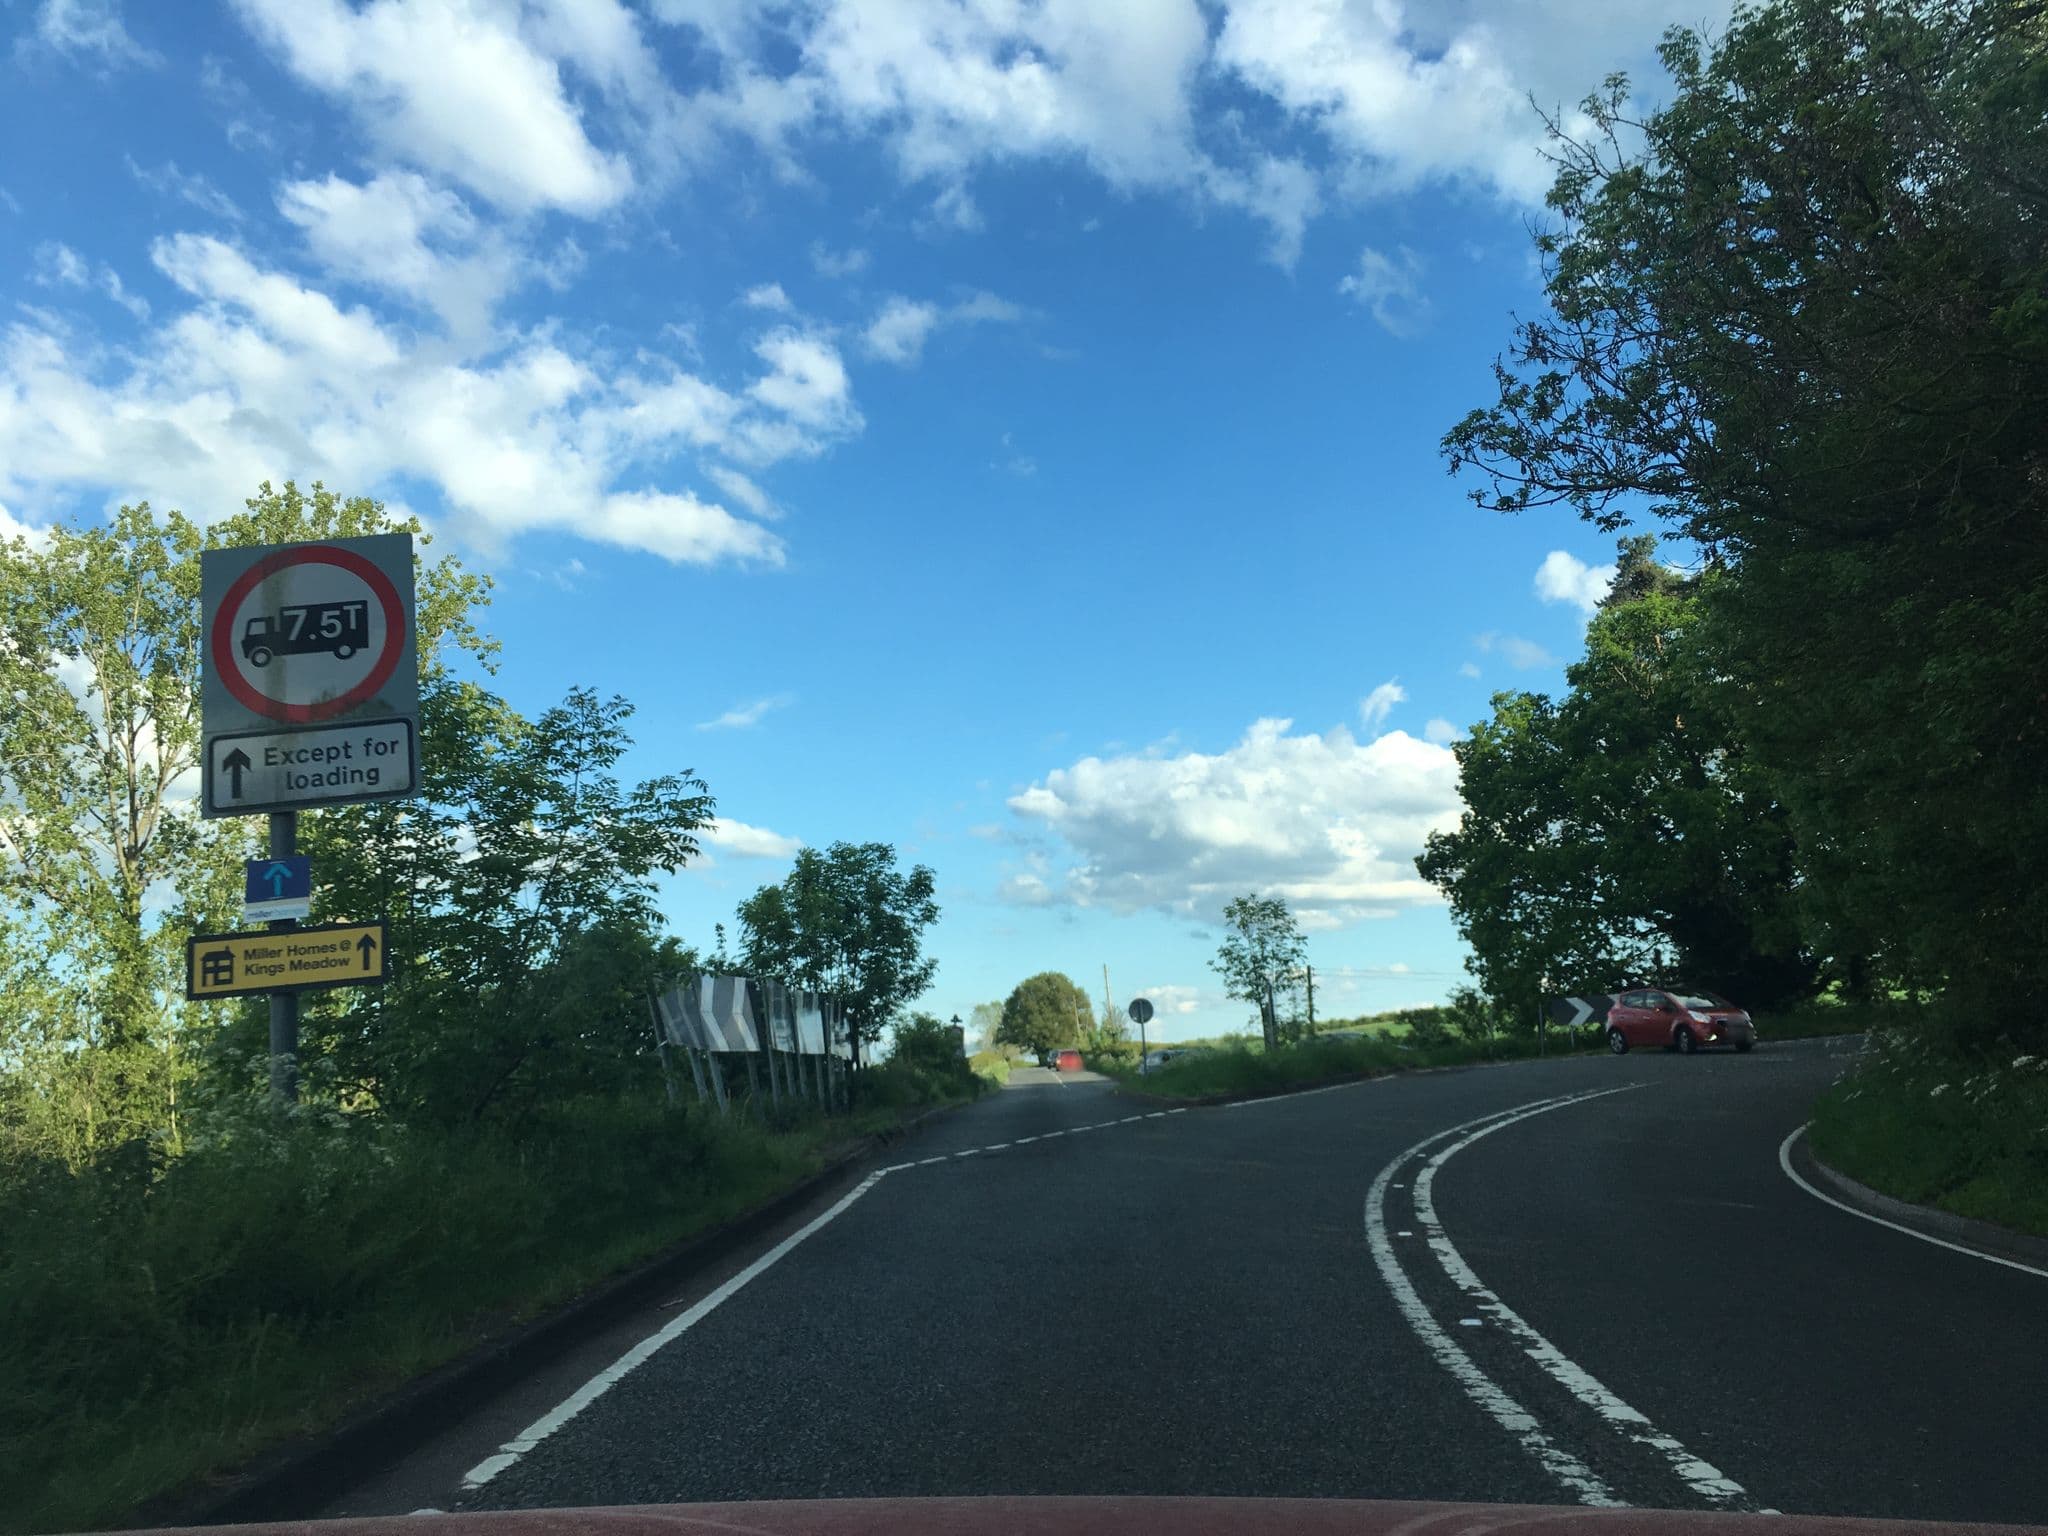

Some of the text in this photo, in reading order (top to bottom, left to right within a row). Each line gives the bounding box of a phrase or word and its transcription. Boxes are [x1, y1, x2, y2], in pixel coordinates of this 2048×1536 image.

[283, 604, 363, 641] 7.5T
[263, 738, 400, 767] Except for
[286, 765, 381, 792] loading
[244, 939, 352, 960] Miller Homes @
[244, 956, 351, 976] Kings Meadow
